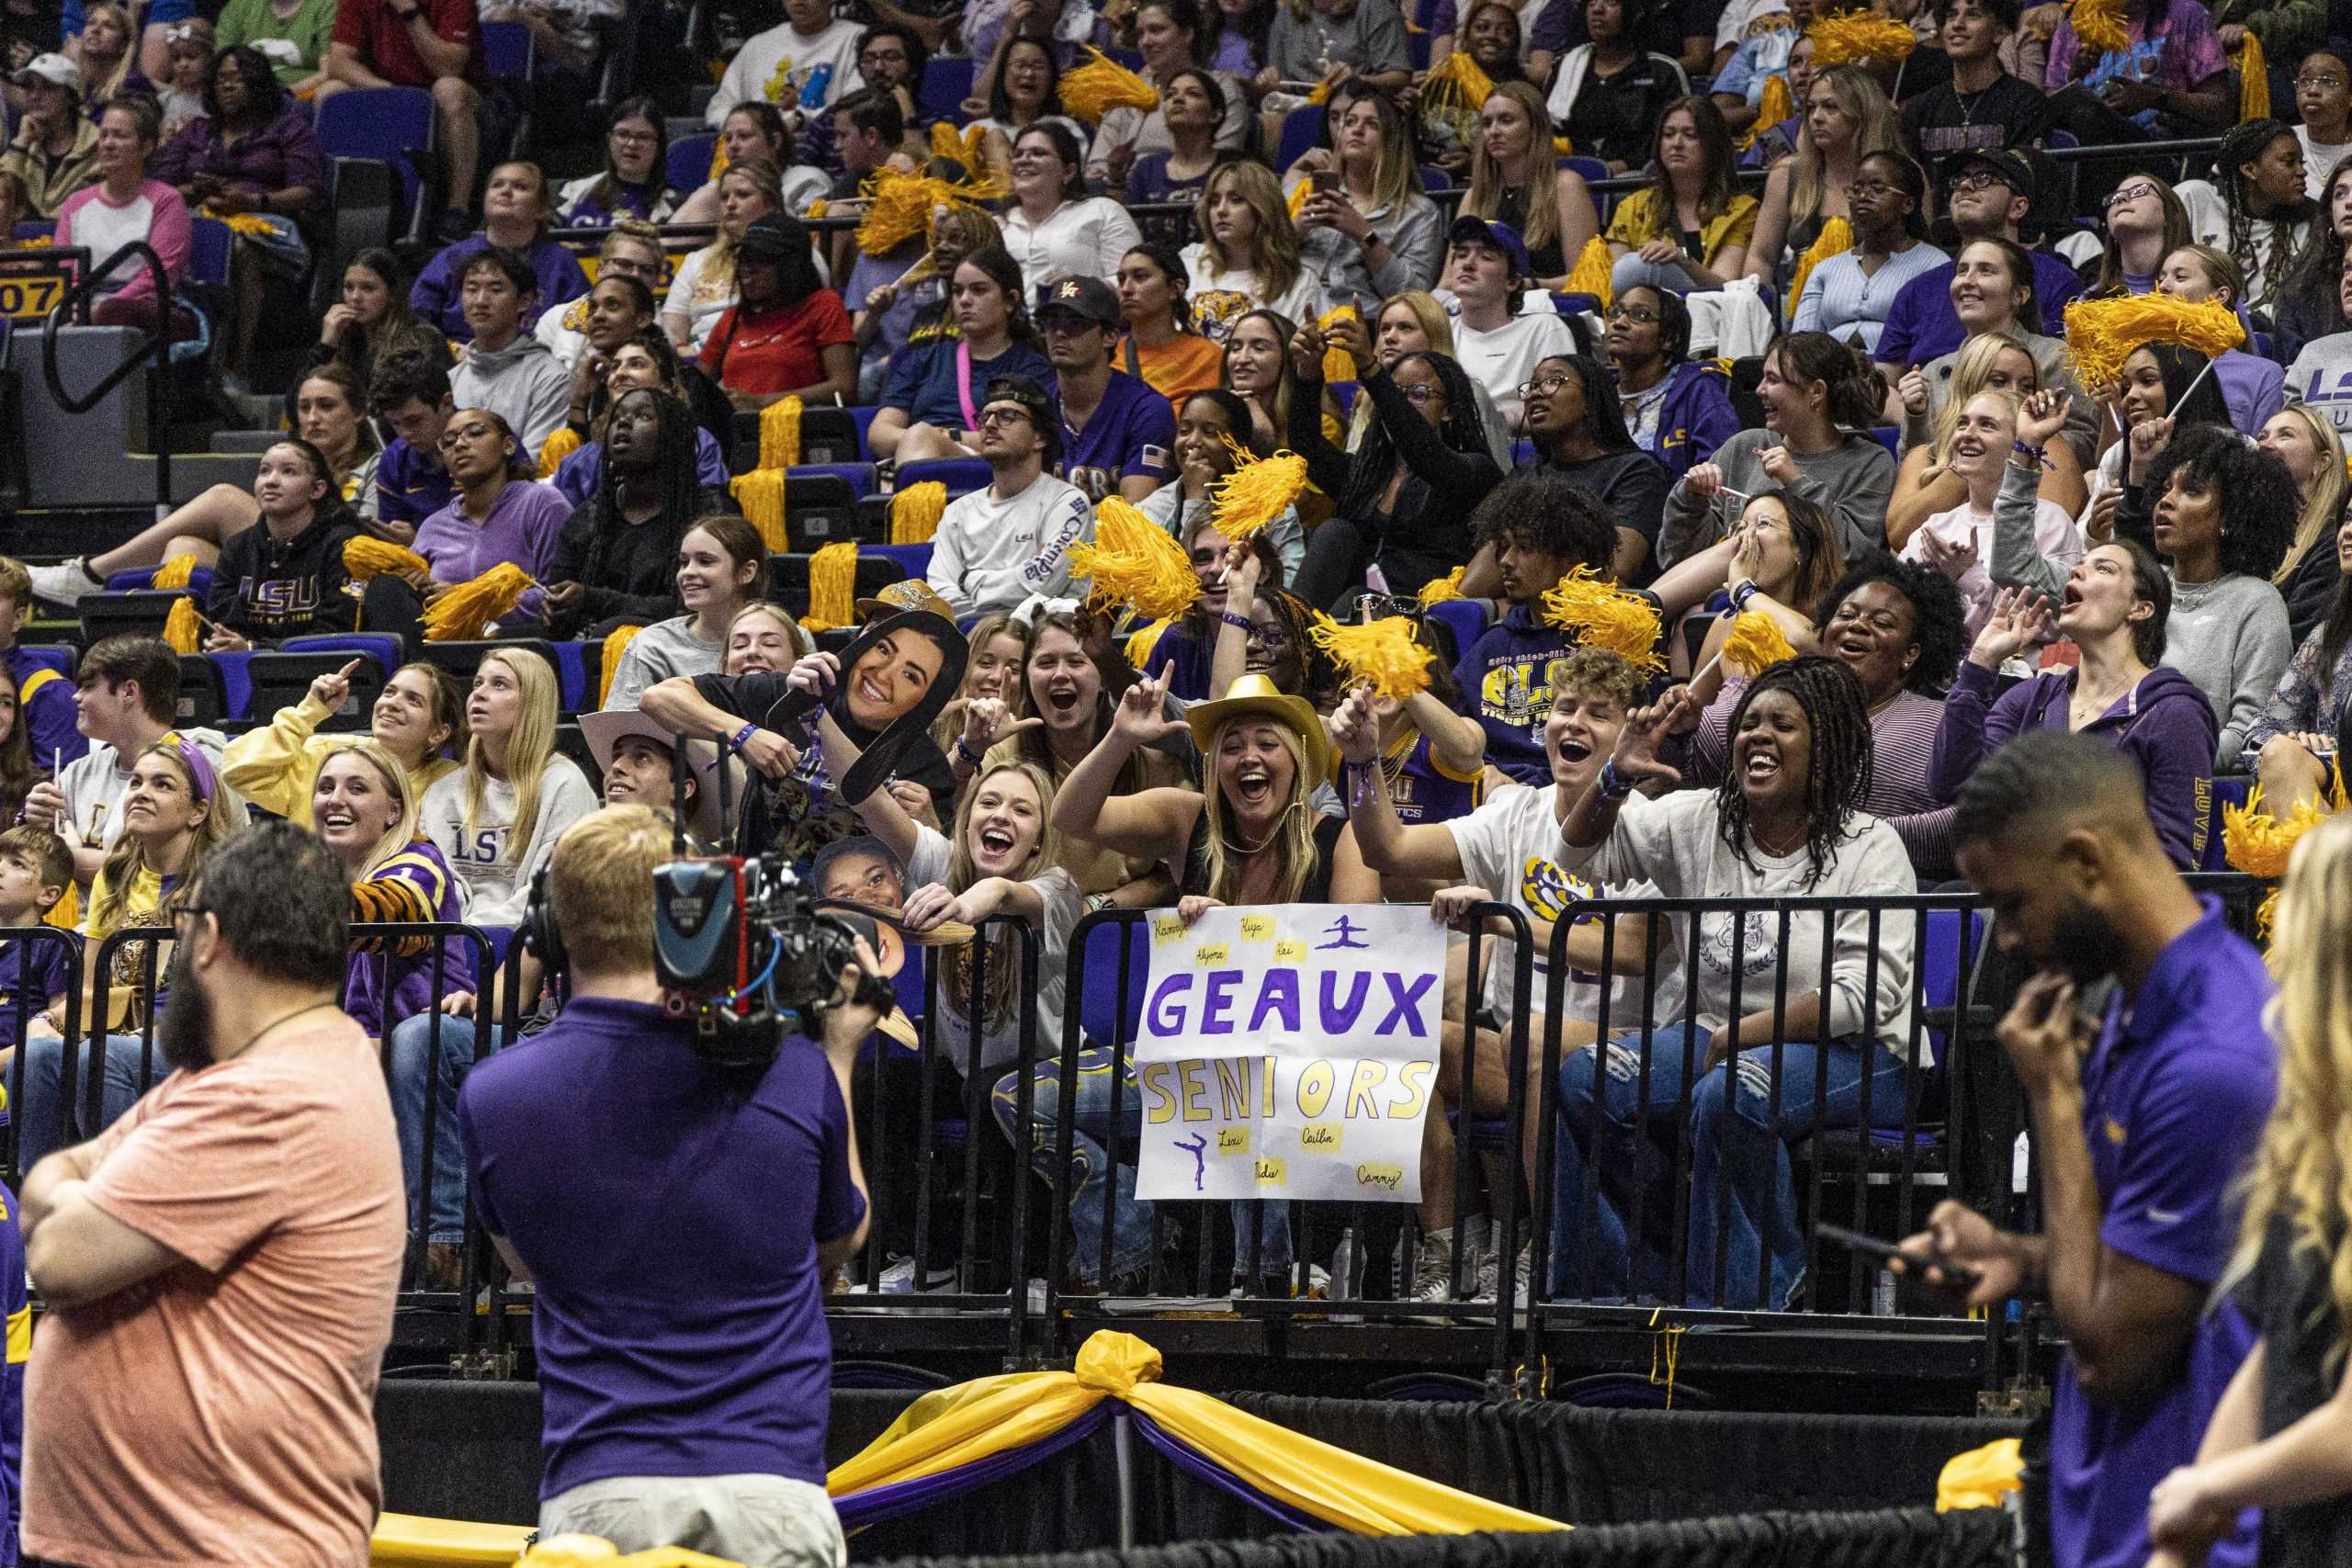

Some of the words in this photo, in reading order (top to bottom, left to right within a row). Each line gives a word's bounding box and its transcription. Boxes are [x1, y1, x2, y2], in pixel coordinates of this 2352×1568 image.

[1023, 515, 1082, 581] Columbia
[239, 573, 321, 615] LSU
[451, 825, 512, 863] LS
[1148, 968, 1439, 1038] GEAUX
[1143, 1056, 1434, 1124] SENIORS
[1302, 1127, 1336, 1145] Caitlin
[1357, 1164, 1402, 1190] Cammy
